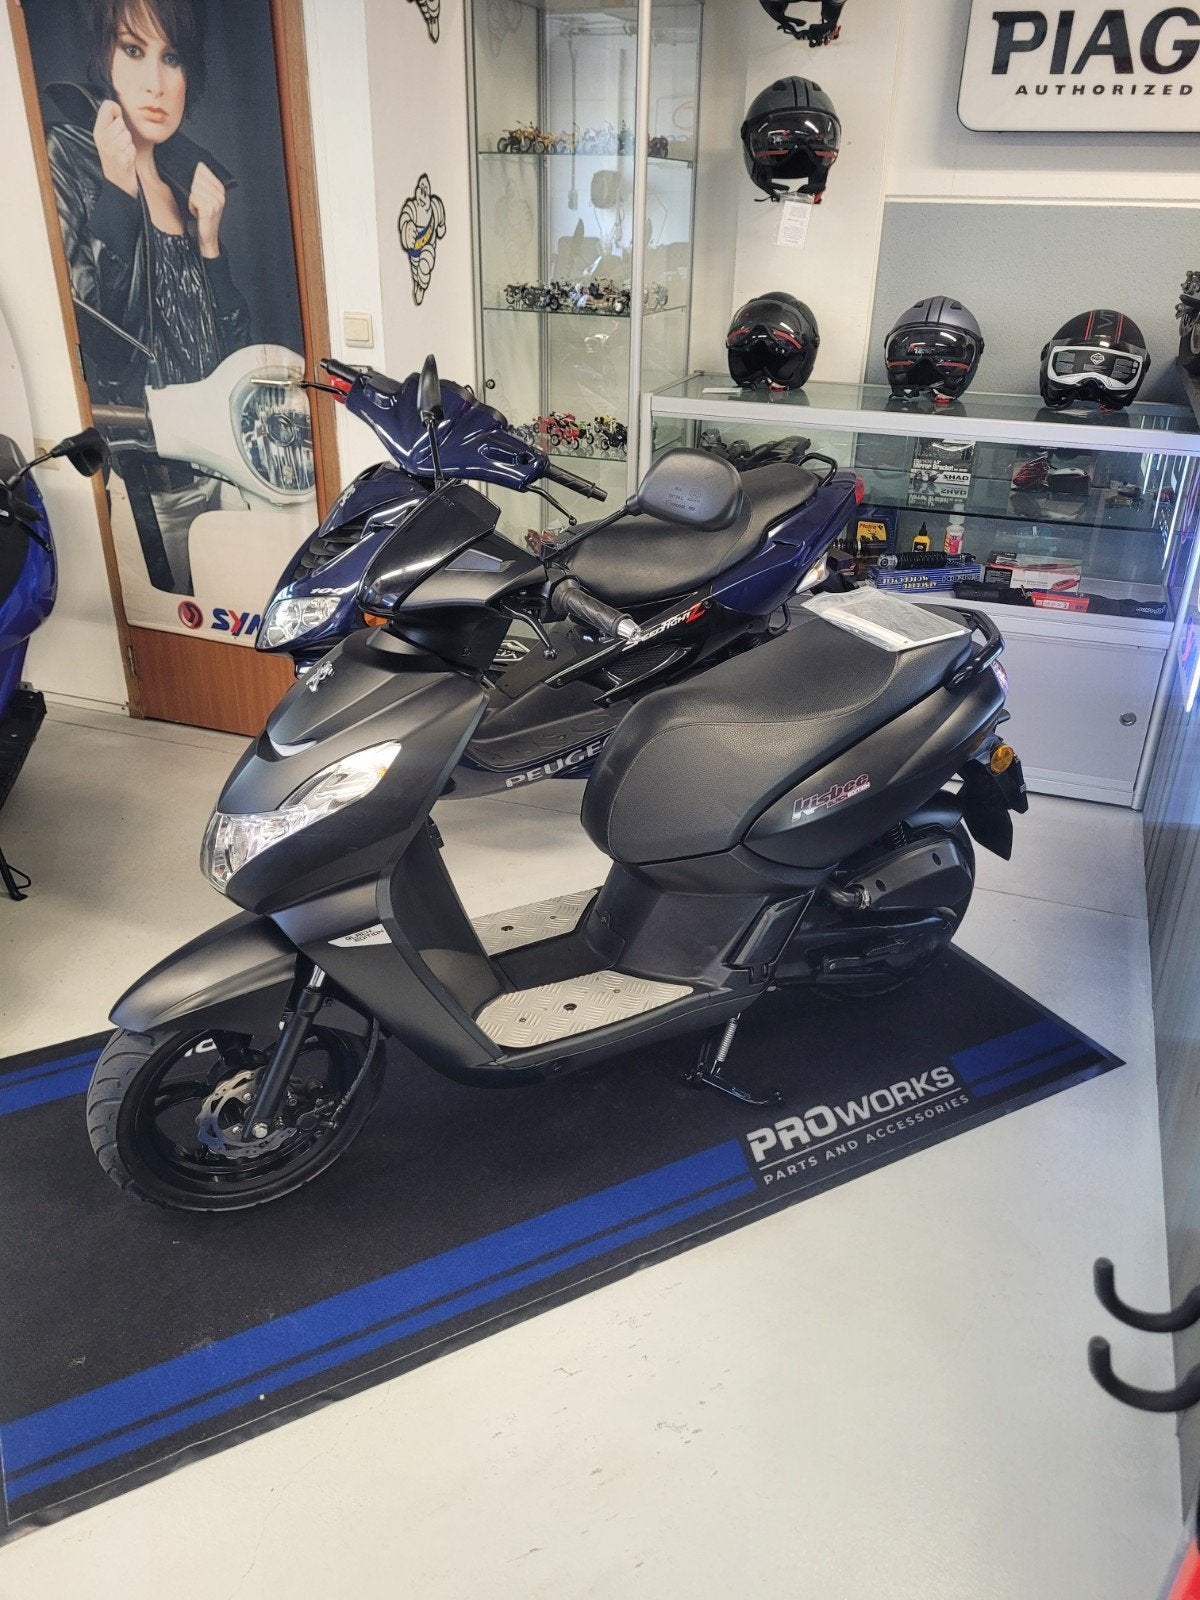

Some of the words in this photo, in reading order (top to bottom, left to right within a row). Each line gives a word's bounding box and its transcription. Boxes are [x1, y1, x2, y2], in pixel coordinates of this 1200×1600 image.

[992, 7, 1200, 75] PIAG
[1015, 84, 1193, 96] AUTHORIZED
[505, 734, 609, 788] PEUGE
[792, 773, 868, 822] Kisbee
[746, 1066, 955, 1163] PROWORKS
[763, 1156, 818, 1186] PARTS
[825, 1139, 859, 1161] AND
[866, 1094, 970, 1144] ACCESSORIES
